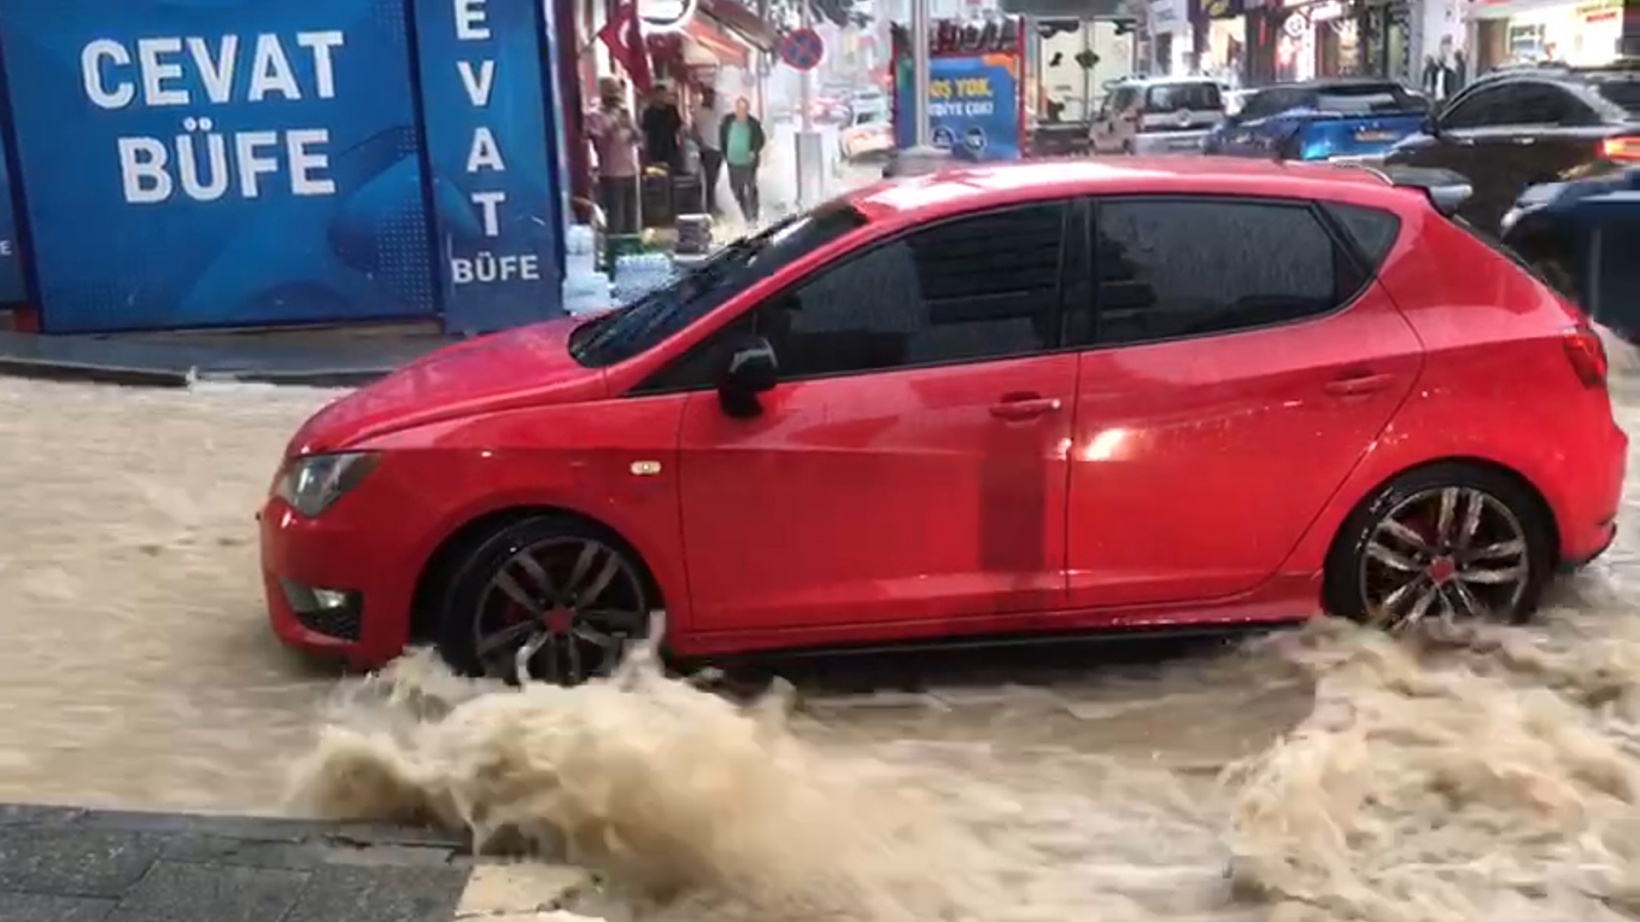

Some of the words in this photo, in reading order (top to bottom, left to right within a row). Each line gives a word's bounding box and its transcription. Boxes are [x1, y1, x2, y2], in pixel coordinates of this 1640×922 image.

[81, 31, 344, 109] CEVAT
[118, 117, 335, 203] BÜFE
[451, 252, 540, 284] BÜFE
